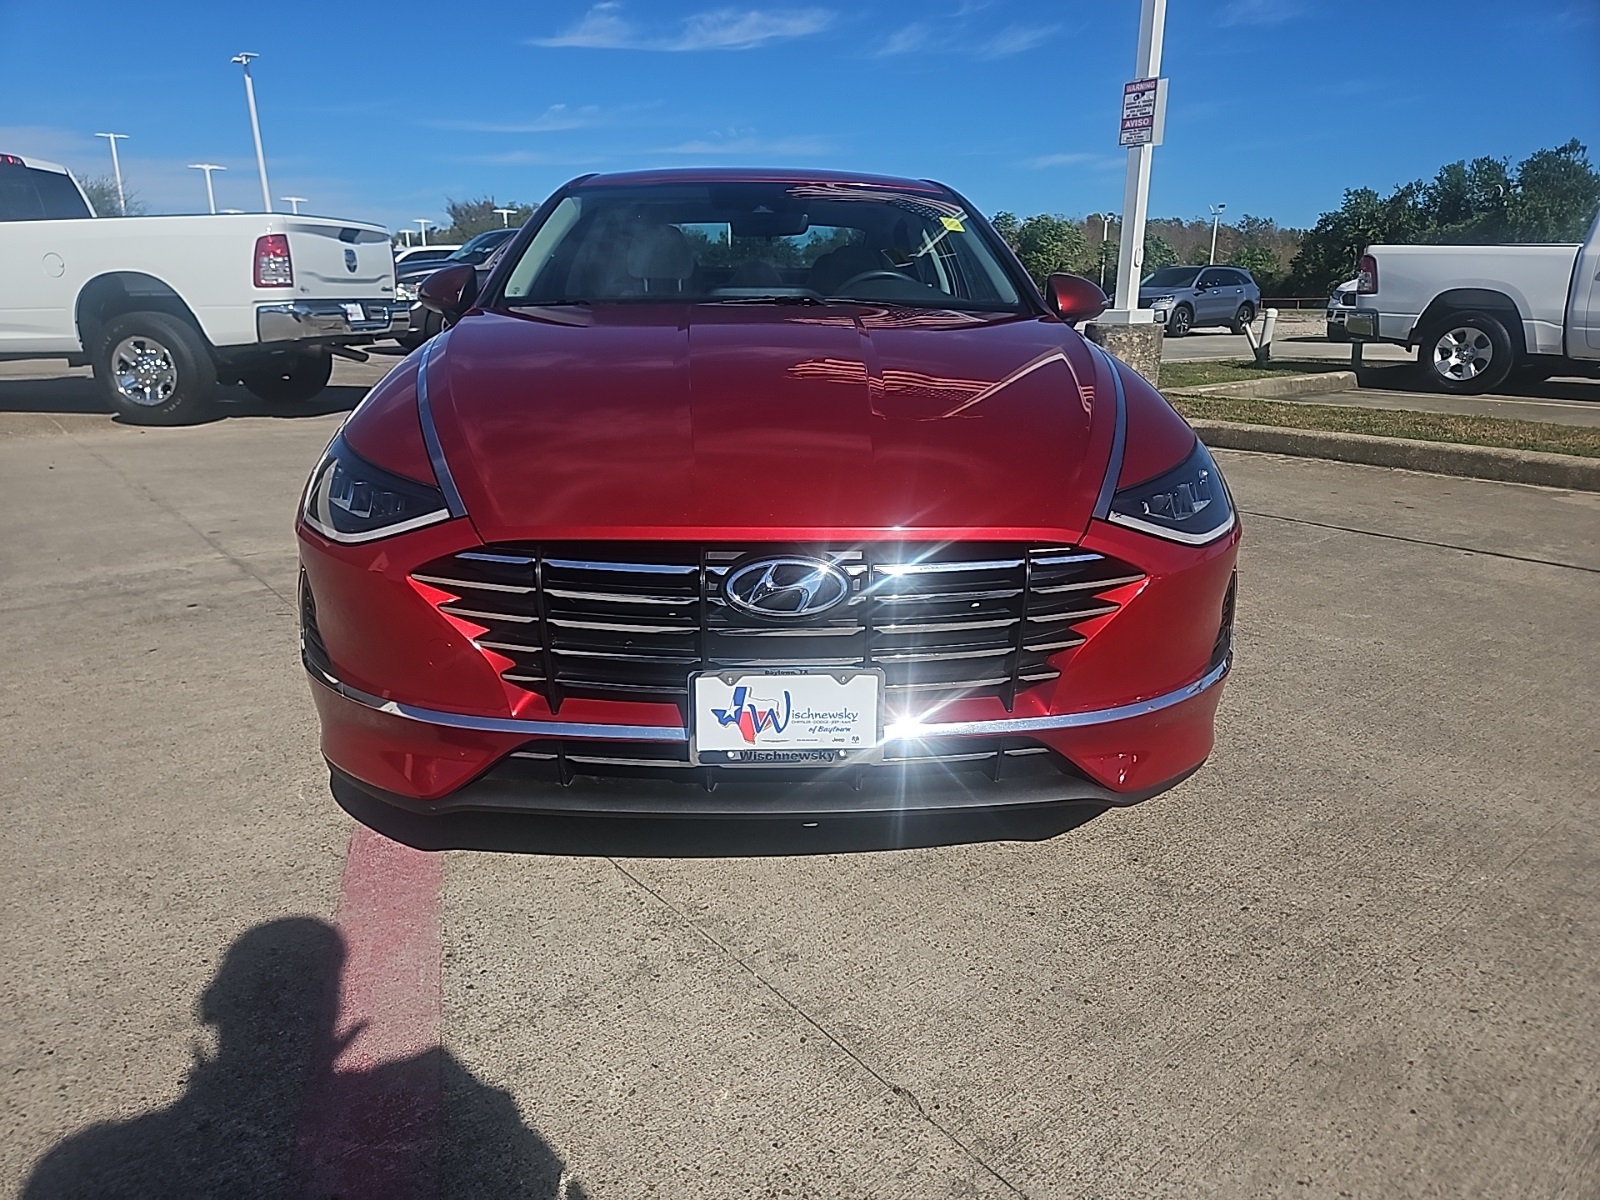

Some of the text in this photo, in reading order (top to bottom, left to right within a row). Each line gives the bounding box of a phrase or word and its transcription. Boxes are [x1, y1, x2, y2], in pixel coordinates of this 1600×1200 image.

[1126, 81, 1155, 92] WARNING
[1124, 118, 1149, 128] AVISO
[748, 690, 859, 734] Wischnewsky
[808, 725, 852, 734] of Baytown
[739, 750, 835, 762] Wischnewsky
